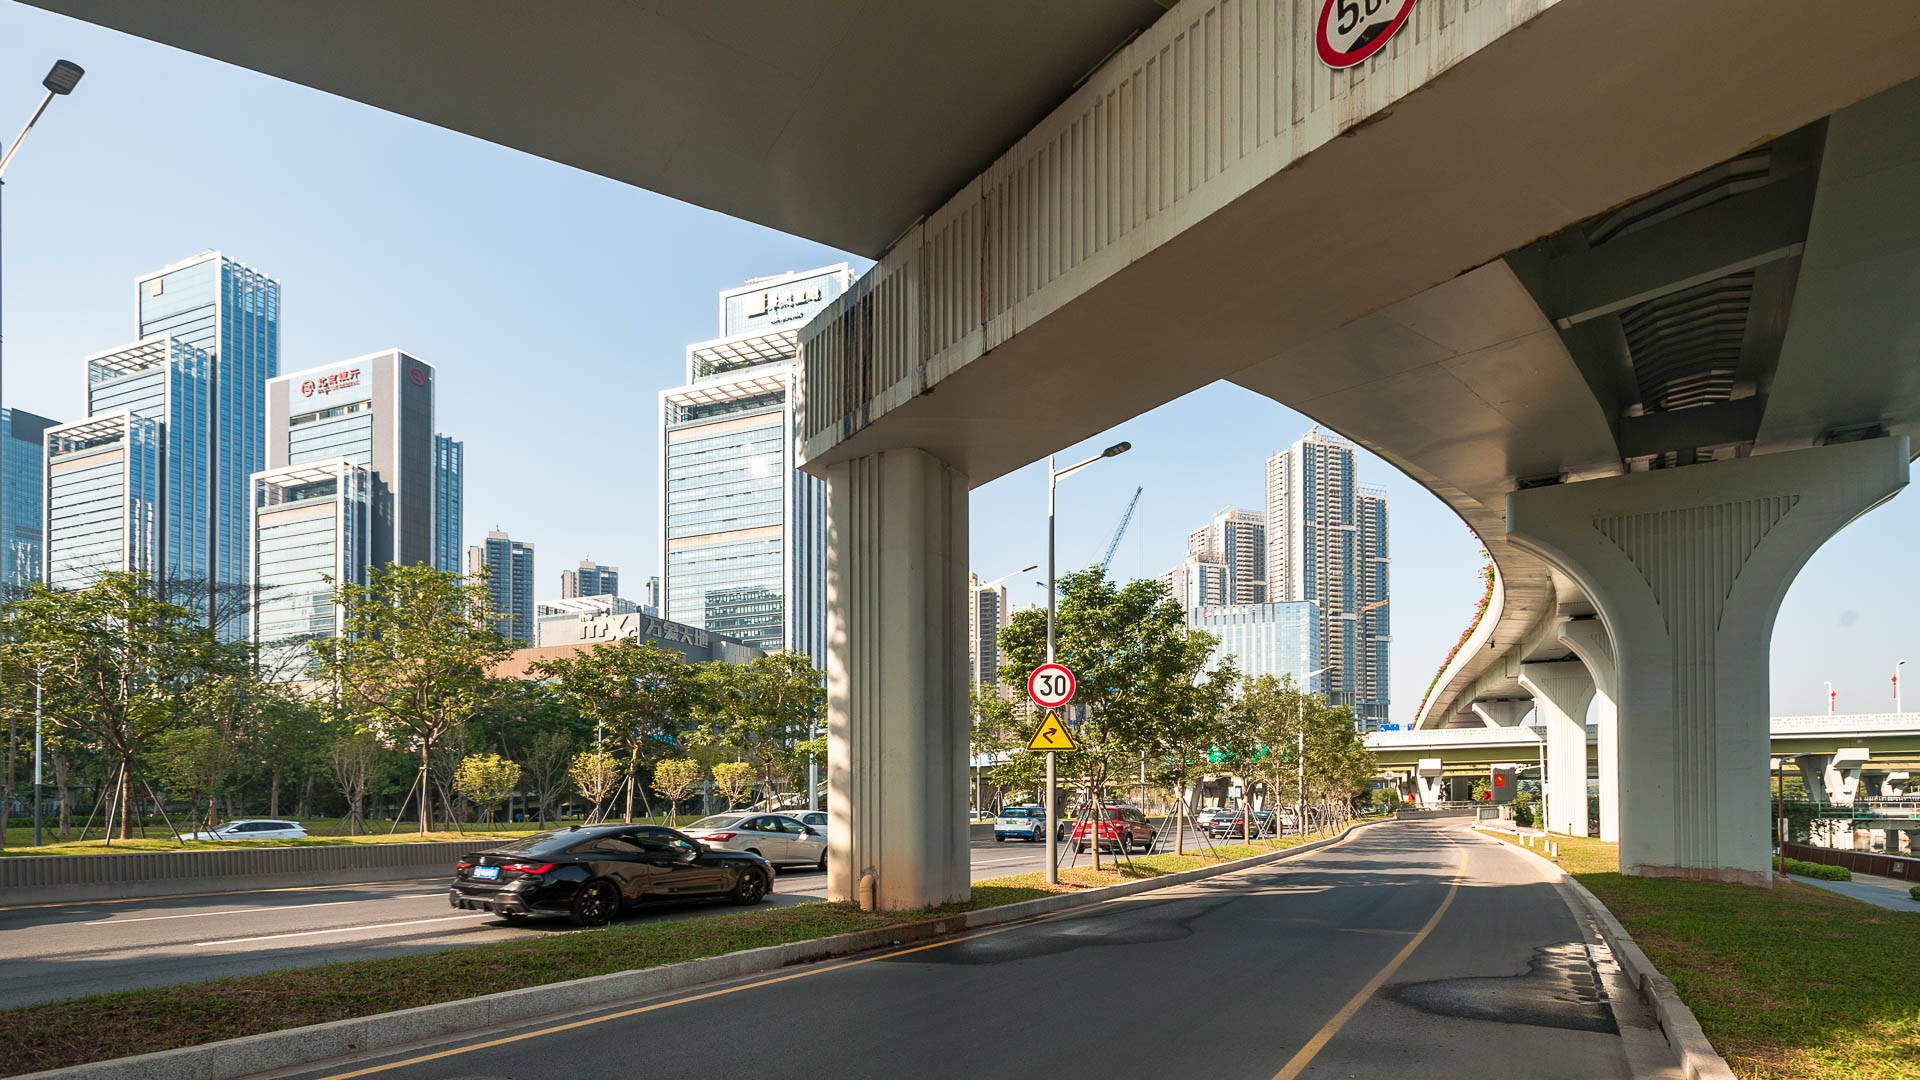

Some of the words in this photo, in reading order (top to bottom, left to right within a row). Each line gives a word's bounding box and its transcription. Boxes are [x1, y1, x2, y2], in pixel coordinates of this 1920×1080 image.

[644, 615, 709, 648] 万象天地
[1040, 675, 1066, 696] 30
